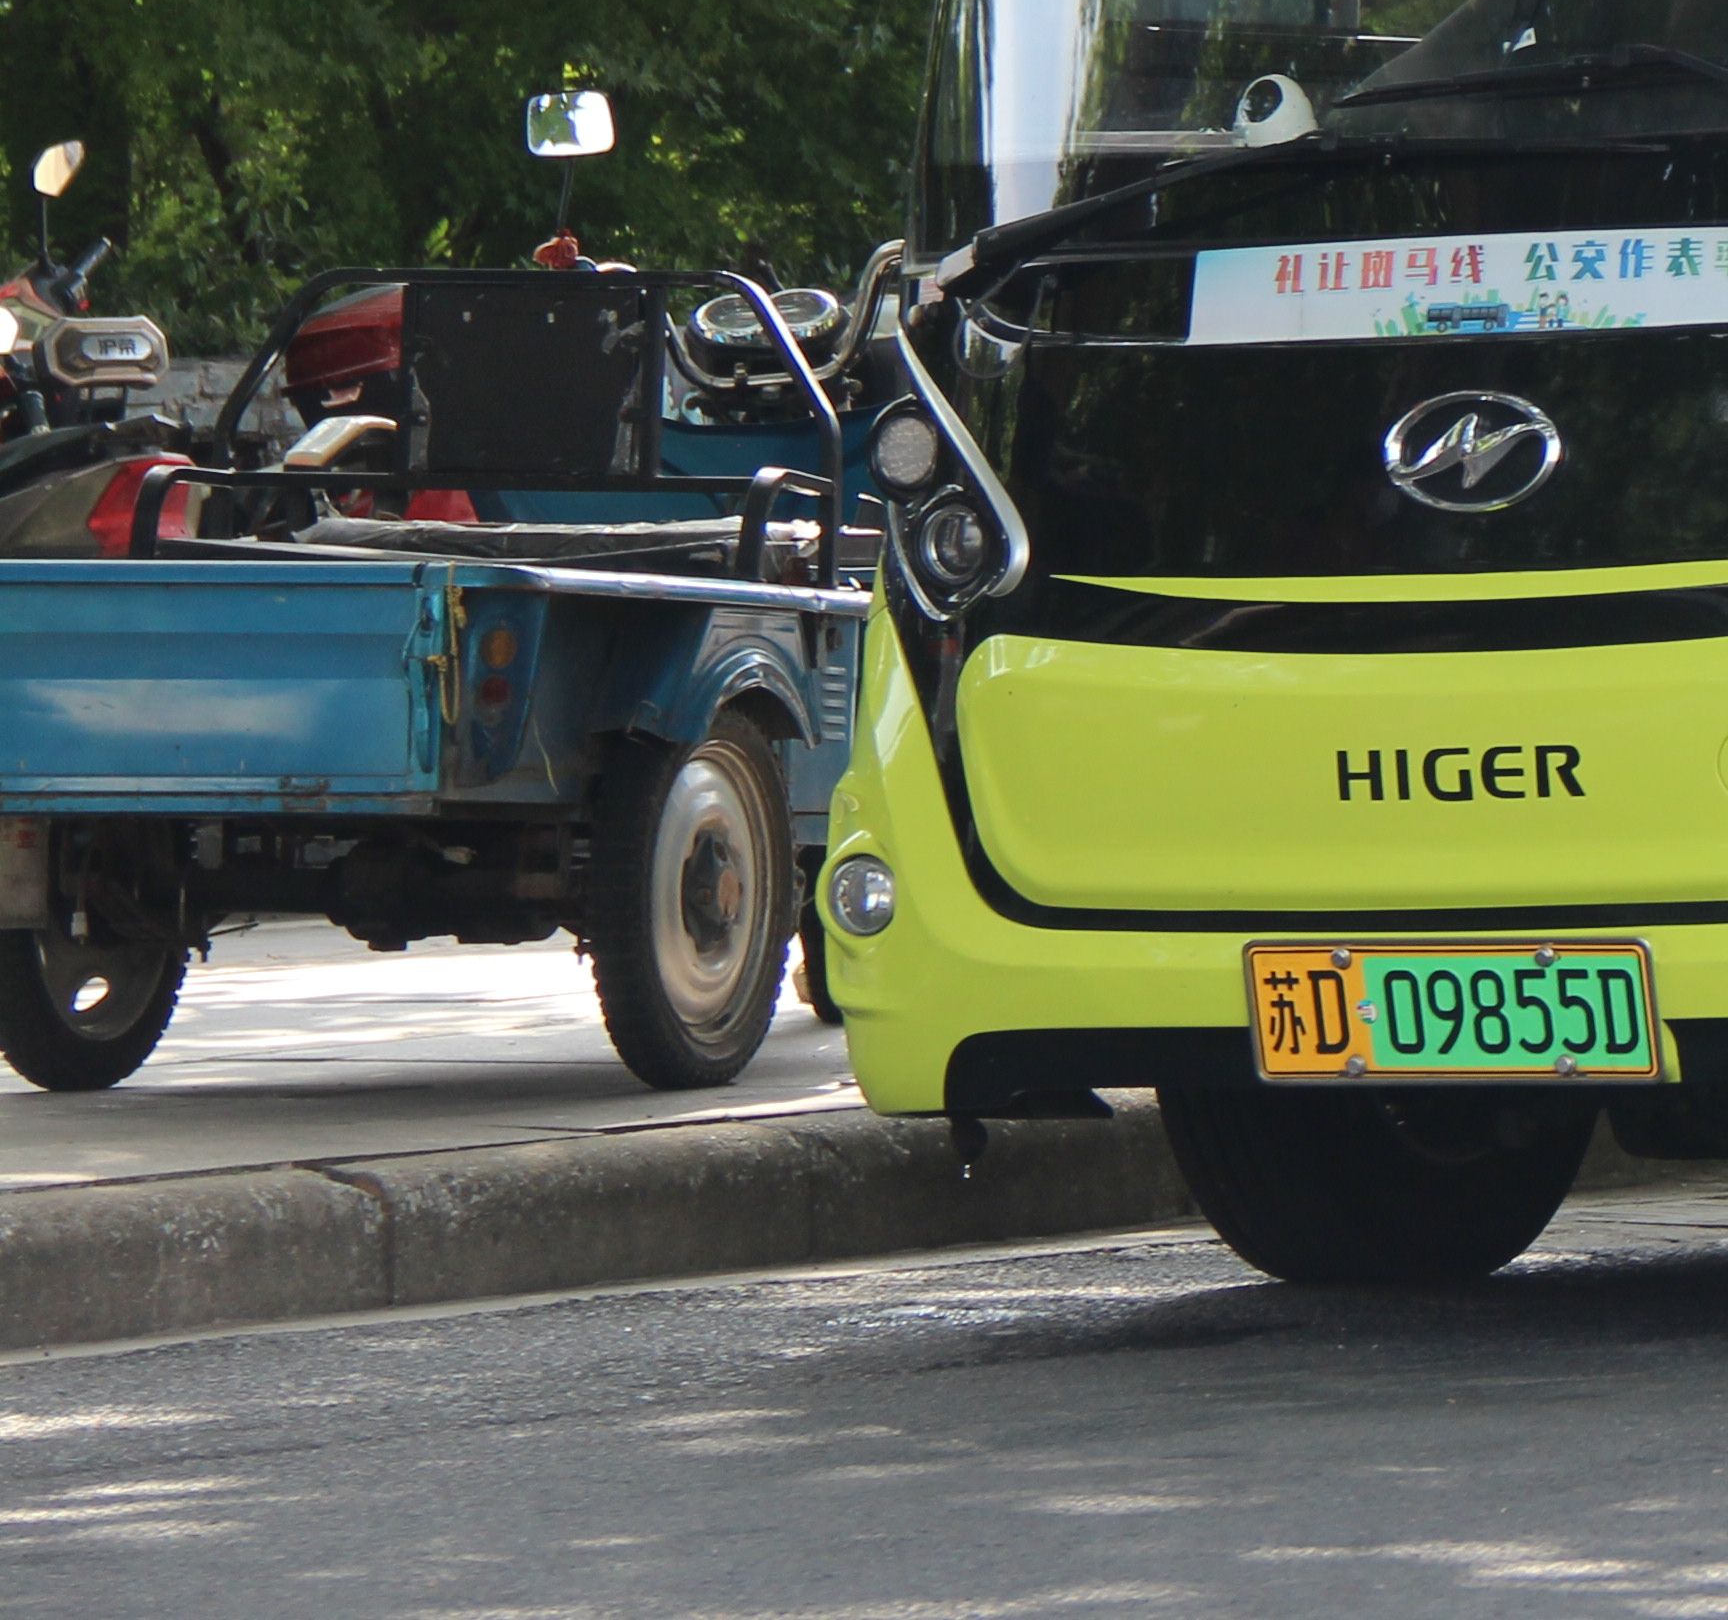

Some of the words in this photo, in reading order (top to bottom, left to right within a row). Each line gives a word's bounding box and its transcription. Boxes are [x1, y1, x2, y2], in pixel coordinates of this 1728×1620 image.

[1275, 245, 1484, 294] 礼让斑马线
[1336, 745, 1586, 801] HIGER
